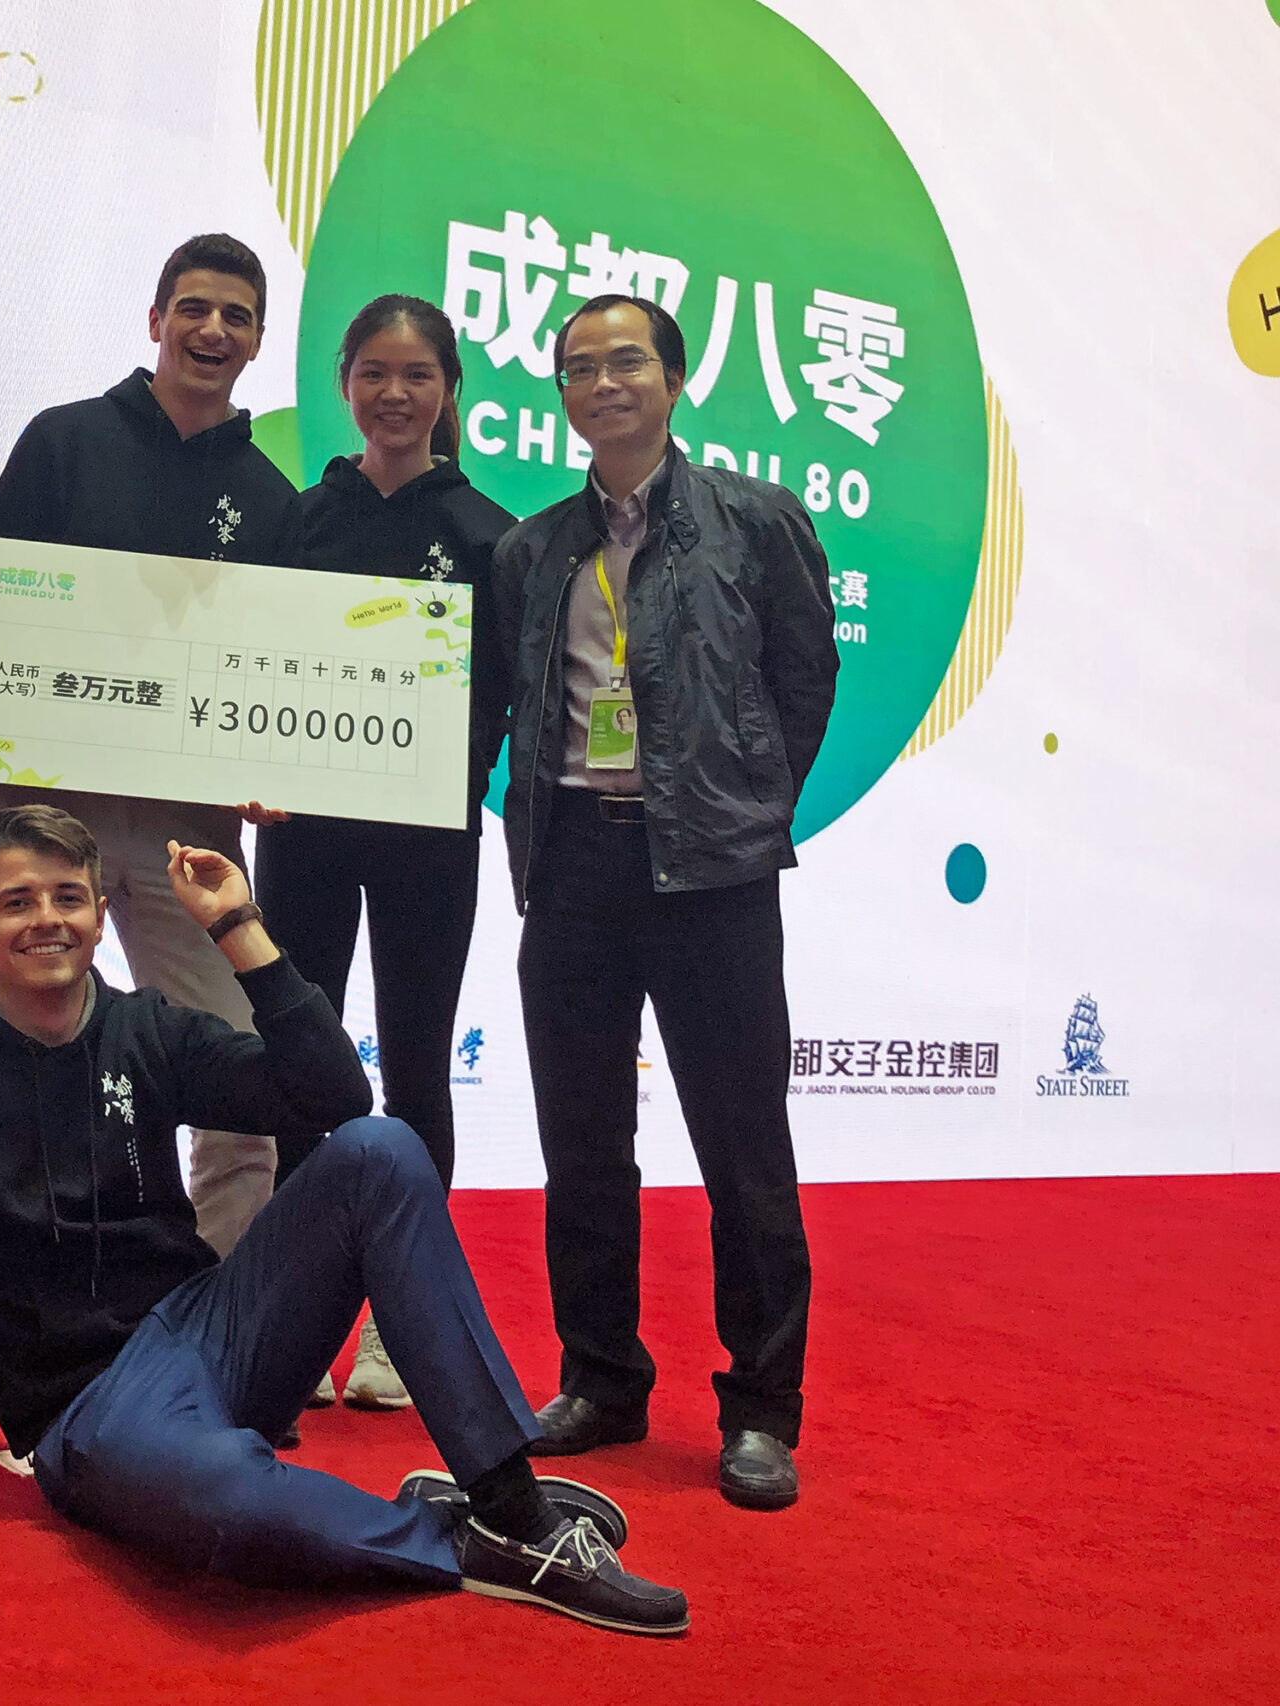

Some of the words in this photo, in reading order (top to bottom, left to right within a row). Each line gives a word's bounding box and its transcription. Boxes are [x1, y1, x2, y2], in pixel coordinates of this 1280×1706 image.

[803, 462, 871, 519] 80
[59, 592, 75, 601] 80
[352, 610, 376, 622] Hello
[378, 602, 402, 614] World
[52, 671, 163, 707] 叁万元整
[806, 1085, 837, 1095] JIAOZI
[840, 1085, 888, 1095] FINANCIAL
[890, 1086, 930, 1096] HOLDING
[933, 1086, 964, 1095] GROUP
[1036, 1075, 1077, 1096] STATE
